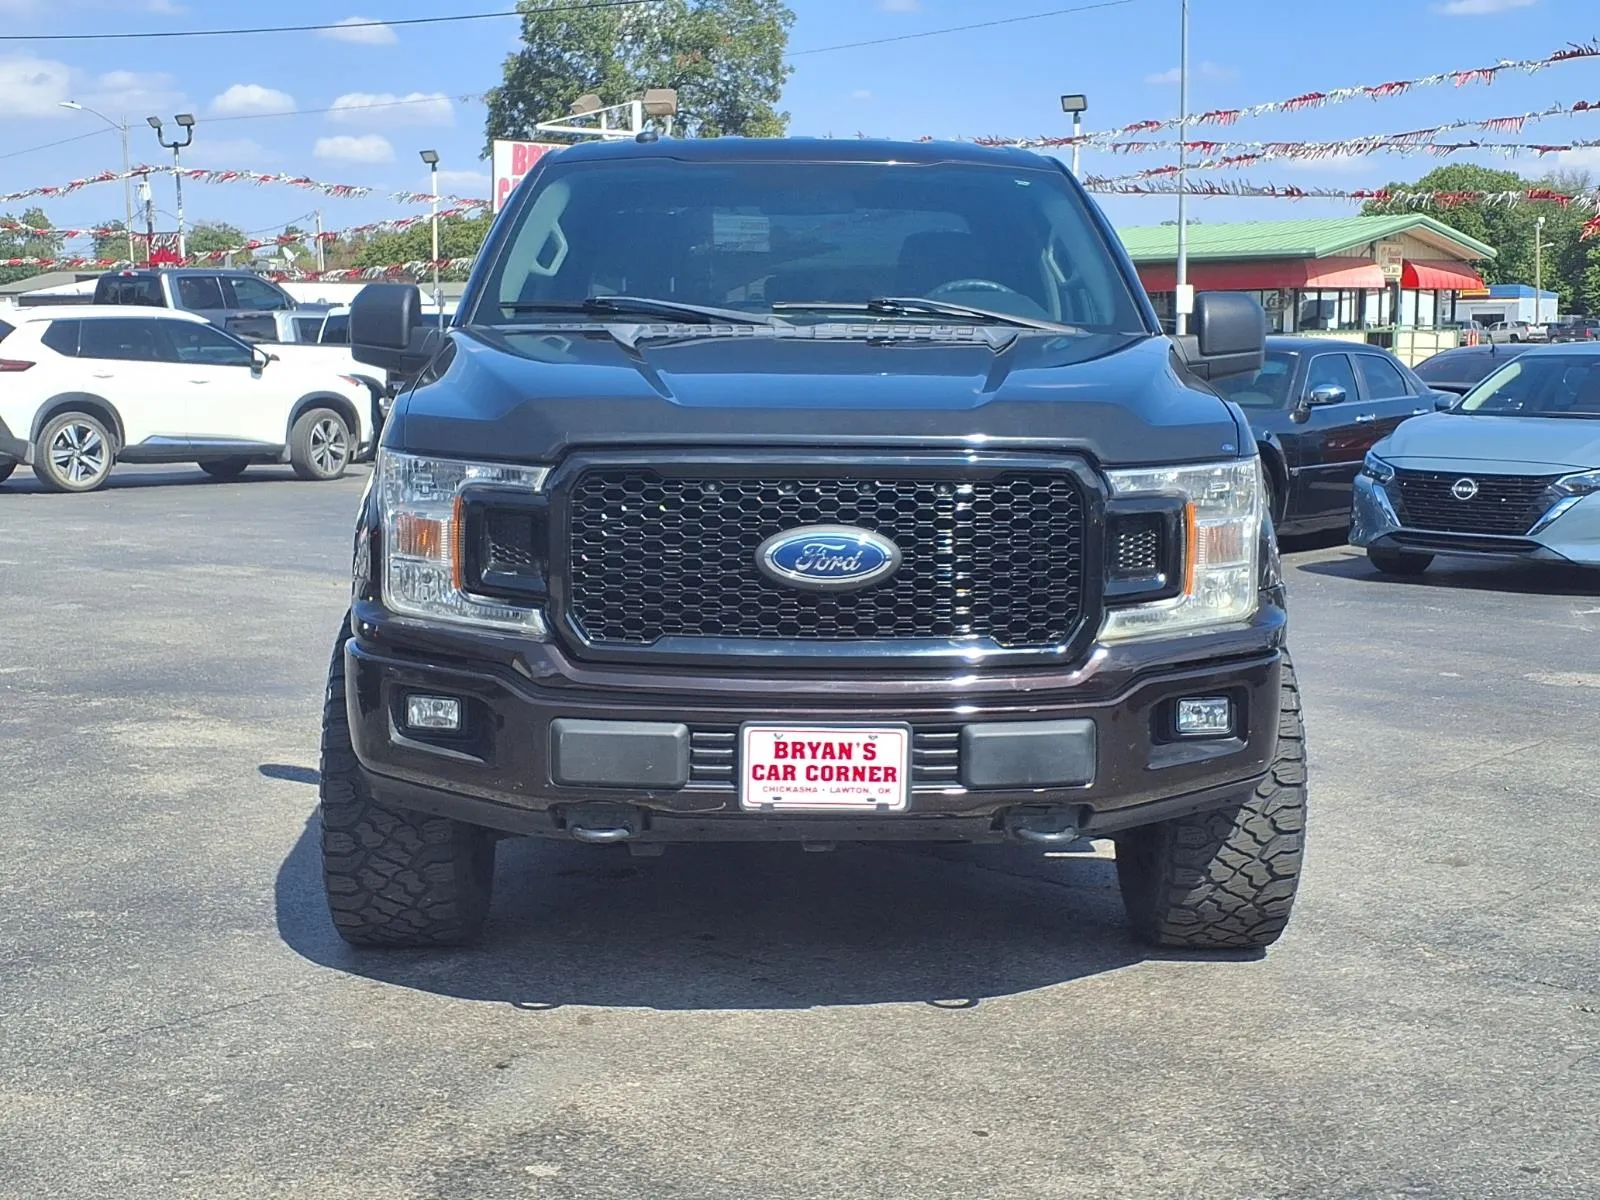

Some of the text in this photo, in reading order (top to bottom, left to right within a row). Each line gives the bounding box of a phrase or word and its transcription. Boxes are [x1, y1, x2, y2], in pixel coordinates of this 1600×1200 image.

[795, 543, 864, 571] Ford
[774, 741, 877, 761] BRYAN'S
[752, 764, 897, 782] CAR CORNER
[762, 785, 818, 793] CHICKASHA
